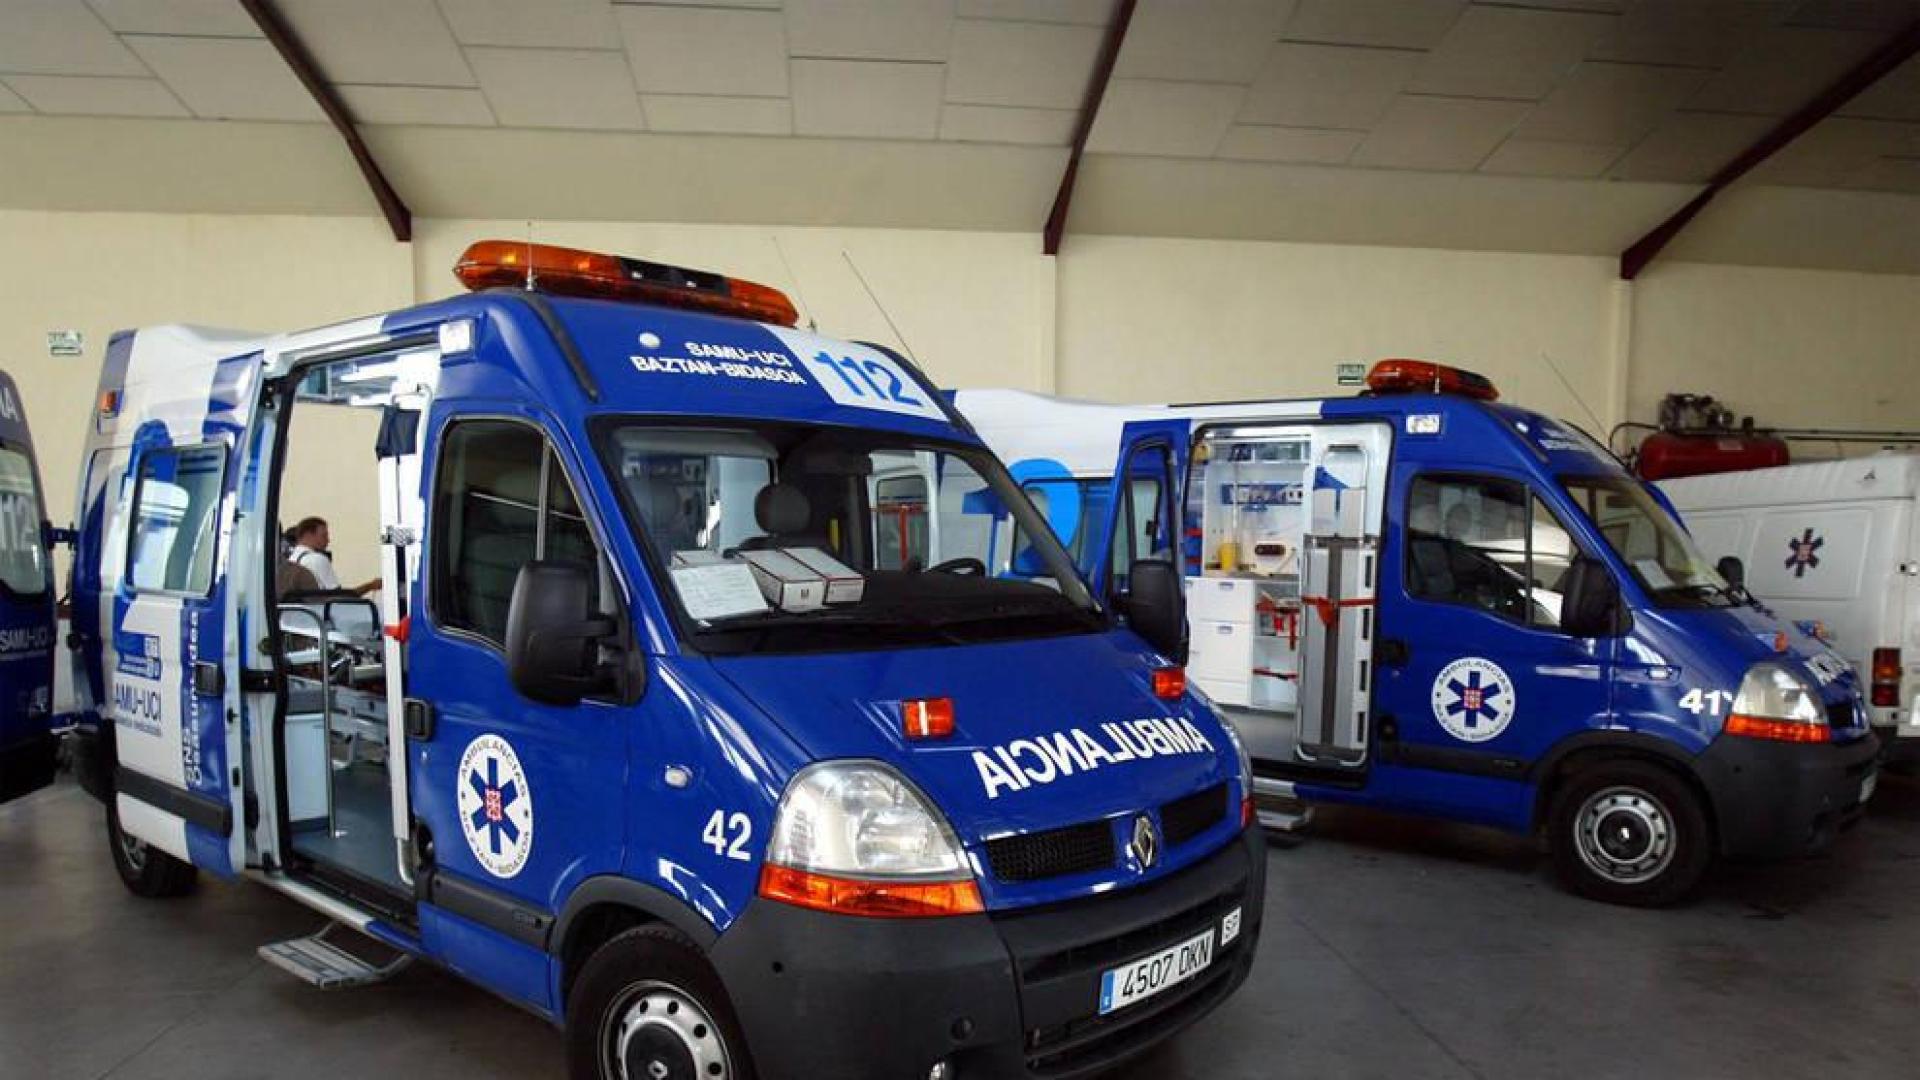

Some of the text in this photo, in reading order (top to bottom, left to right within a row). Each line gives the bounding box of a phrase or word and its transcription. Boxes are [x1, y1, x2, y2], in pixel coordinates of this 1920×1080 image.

[630, 355, 808, 385] BAZTAN-BIDASOA
[684, 341, 792, 368] SAMU-UCI
[814, 351, 923, 406] 112
[1679, 687, 1721, 716] 41
[703, 809, 752, 861] 42
[1122, 936, 1211, 996] 4507 DKN
